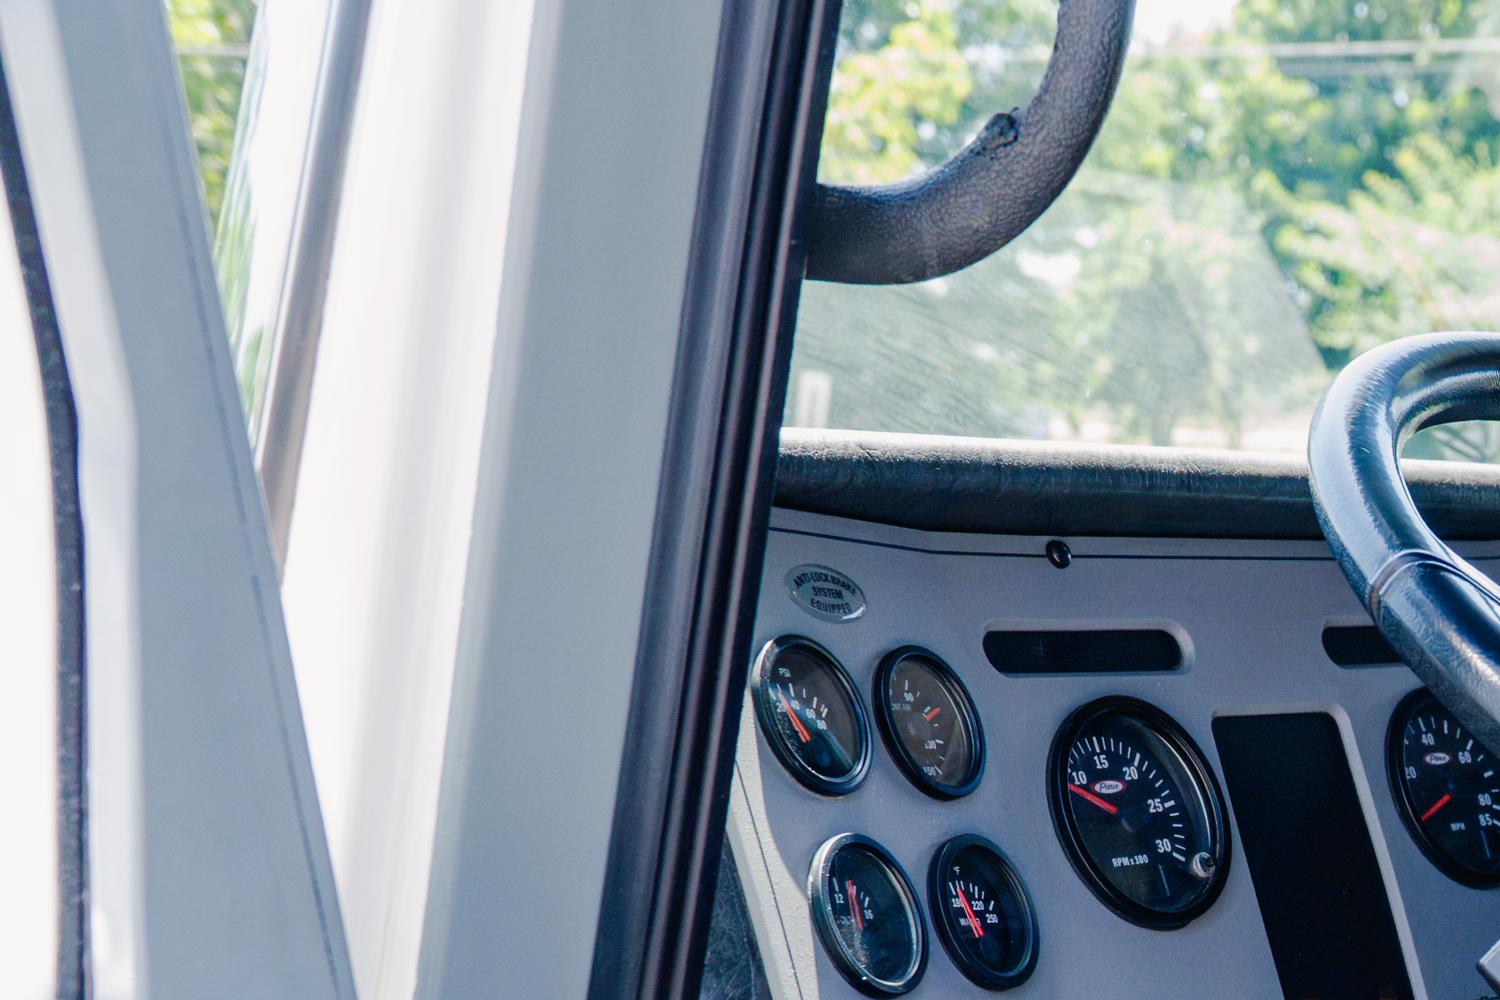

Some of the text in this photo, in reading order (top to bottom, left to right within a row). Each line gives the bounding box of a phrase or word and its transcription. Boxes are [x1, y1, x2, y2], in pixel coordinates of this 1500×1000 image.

[812, 586, 843, 599] SYSTEM
[810, 598, 852, 614] EQUIPPED
[1422, 733, 1435, 746] 40
[1093, 754, 1109, 769] 15
[1458, 751, 1471, 764] 60
[1072, 770, 1087, 785] 10
[1123, 766, 1139, 780] 20
[1478, 793, 1491, 805] 80
[1148, 799, 1163, 813] 25
[1479, 814, 1493, 827] 85
[1156, 838, 1171, 853] 30
[834, 894, 844, 904] 12
[972, 901, 985, 911] 220
[986, 914, 999, 924] 250
